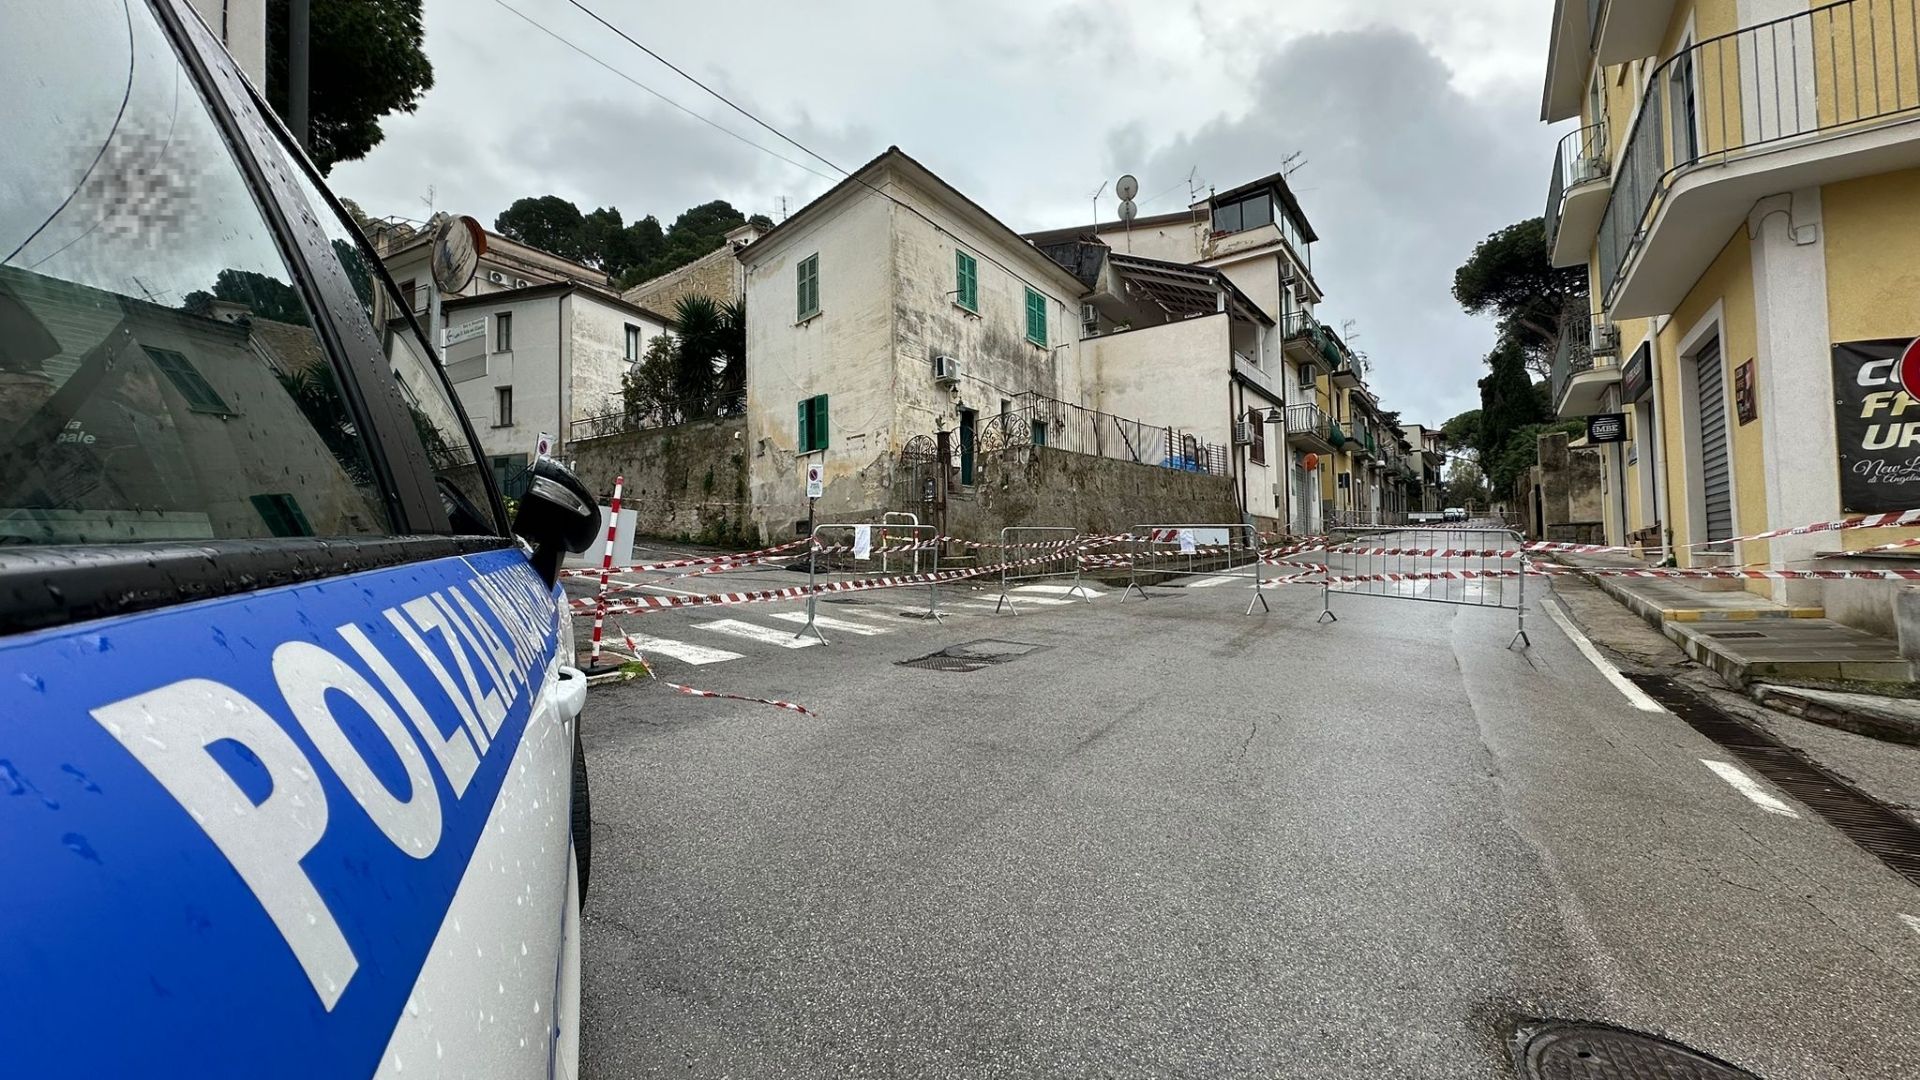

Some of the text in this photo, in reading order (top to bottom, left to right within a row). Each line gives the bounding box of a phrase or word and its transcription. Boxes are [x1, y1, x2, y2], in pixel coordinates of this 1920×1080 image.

[1596, 424, 1619, 433] MBE
[1853, 459, 1901, 476] New
[89, 585, 526, 1013] POLIZIA
